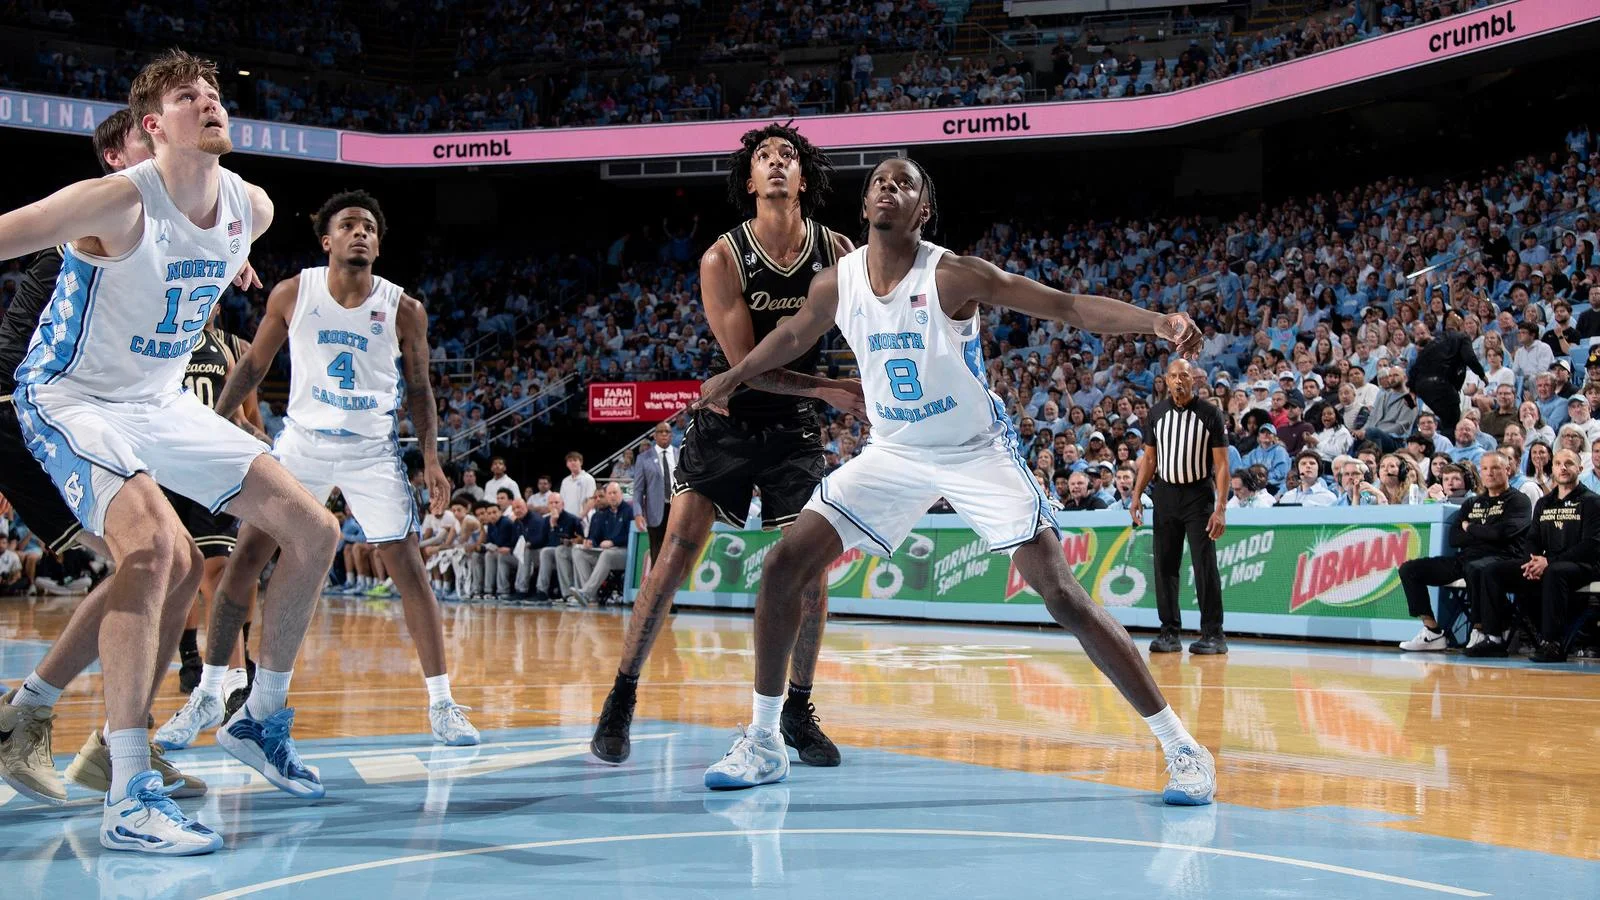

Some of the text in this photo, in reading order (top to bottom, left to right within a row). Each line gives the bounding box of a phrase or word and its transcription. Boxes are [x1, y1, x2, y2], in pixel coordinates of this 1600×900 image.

[1429, 10, 1516, 52] crumbl
[943, 112, 1030, 135] crumbl
[230, 123, 308, 153] BALL
[433, 139, 512, 158] crumbl
[166, 260, 227, 281] NORTH
[156, 285, 220, 334] 13
[749, 291, 807, 311] Deaco
[318, 329, 368, 352] NORTH
[868, 332, 925, 352] NORTH
[186, 363, 225, 376] eacons
[327, 351, 355, 390] 4
[885, 358, 923, 401] 8
[312, 385, 378, 410] CAROLINA
[593, 397, 632, 407] BUREAU
[604, 388, 632, 397] FARM
[650, 391, 678, 401] Helping
[678, 391, 692, 400] You
[644, 401, 662, 409] What
[663, 401, 674, 409] We
[876, 395, 957, 423] CAROLINA
[936, 558, 990, 595] Spin Mop
[1230, 561, 1266, 586] Mop
[1289, 529, 1412, 612] LIBMAN
